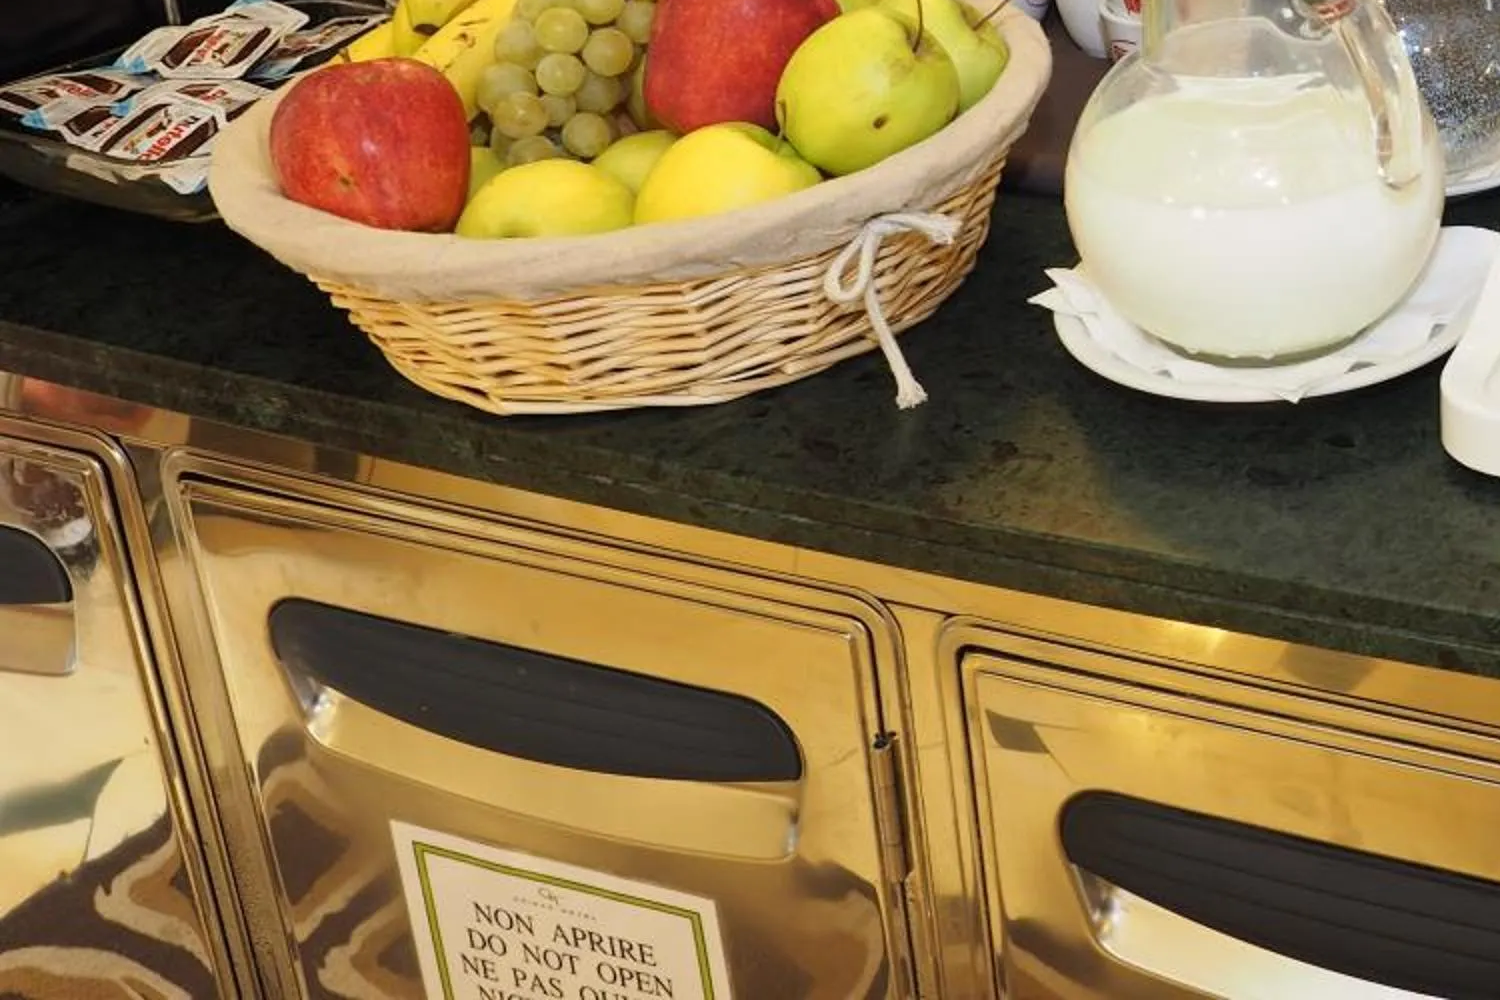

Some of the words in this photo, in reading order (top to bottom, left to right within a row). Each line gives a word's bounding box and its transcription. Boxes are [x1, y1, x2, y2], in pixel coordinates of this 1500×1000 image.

[467, 927, 508, 957] DO
[522, 942, 580, 975] NOT
[597, 961, 674, 999] OPEN
[472, 901, 536, 936] NON
[552, 923, 657, 967] APRIRE
[460, 952, 499, 982] NE
[511, 967, 564, 999] PAS
